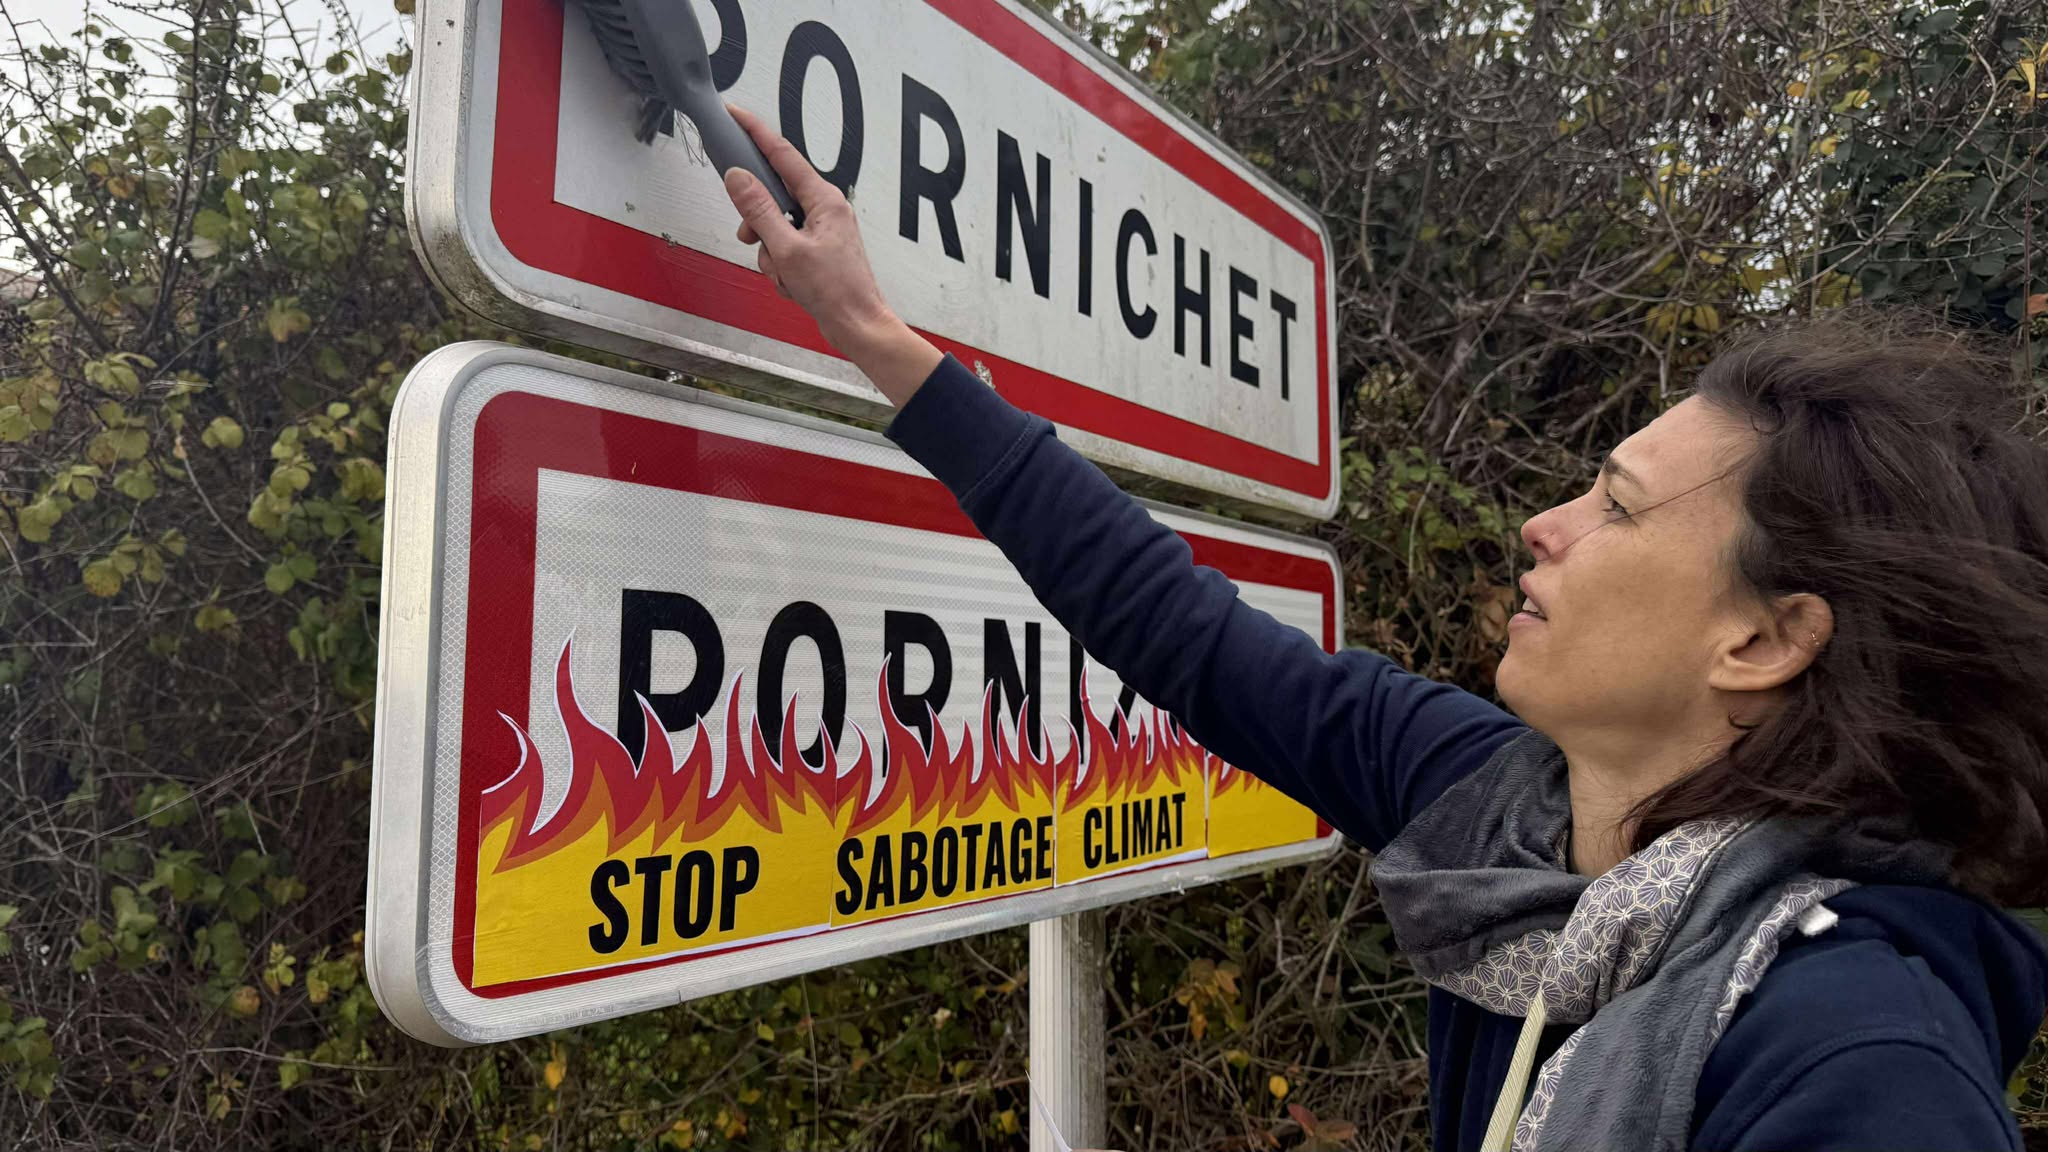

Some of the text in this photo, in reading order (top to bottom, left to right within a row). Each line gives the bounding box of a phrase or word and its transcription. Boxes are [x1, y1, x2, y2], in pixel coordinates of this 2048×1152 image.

[656, 0, 1297, 401] ORNICHET
[588, 792, 1186, 954] STOP SABOTAGE CLIMAT
